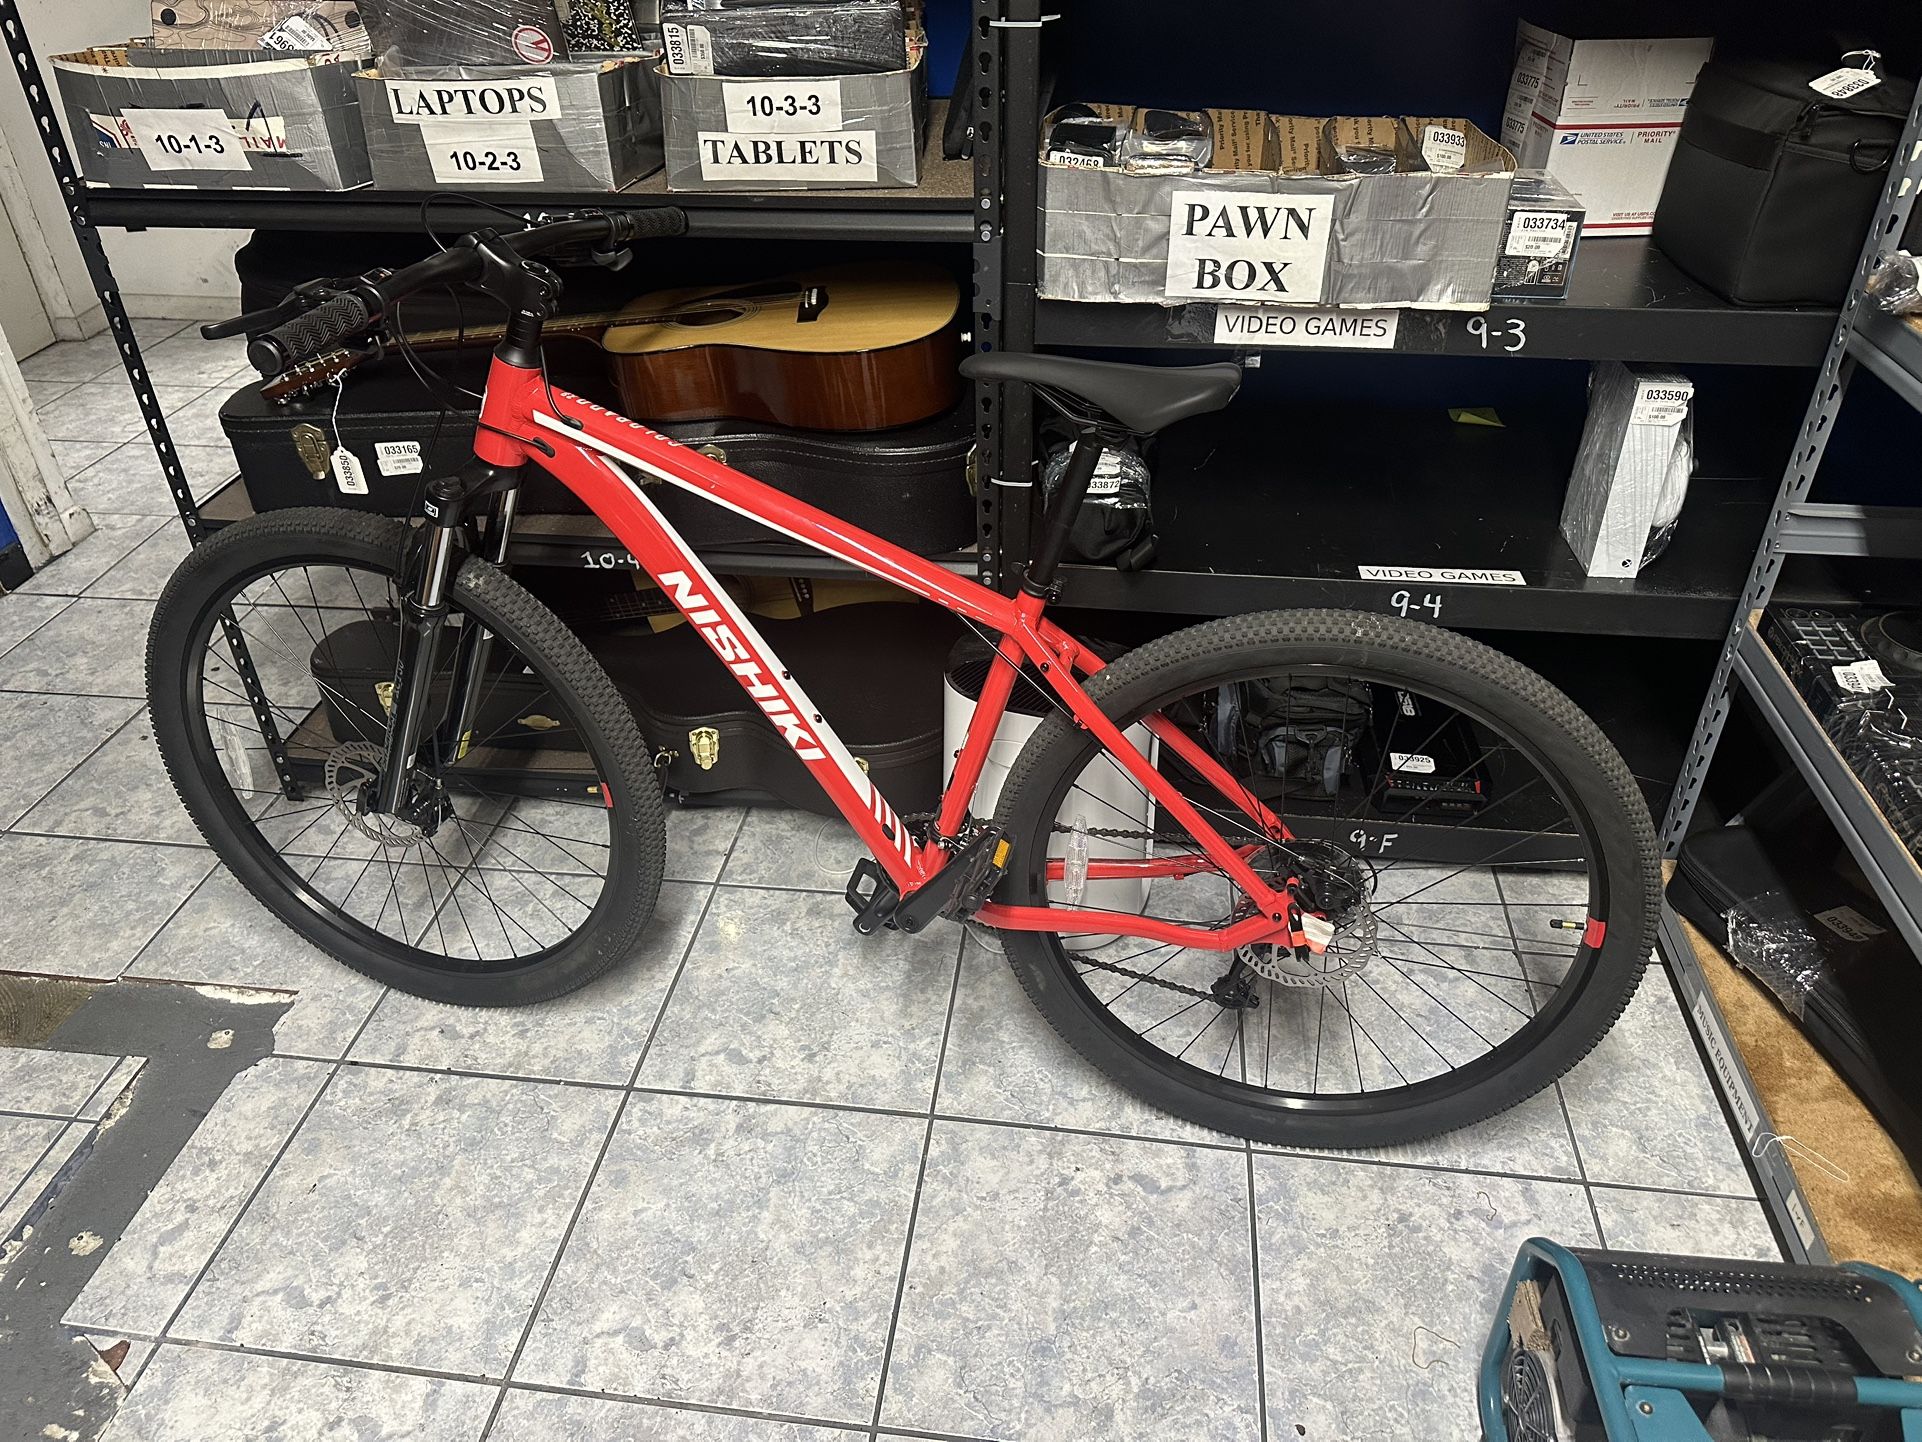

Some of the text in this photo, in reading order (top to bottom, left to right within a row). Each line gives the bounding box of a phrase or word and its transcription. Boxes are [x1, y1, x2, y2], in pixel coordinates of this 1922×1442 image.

[668, 27, 685, 65] 033815
[1516, 72, 1540, 89] 033775
[390, 86, 547, 116] LAPTOPS
[746, 94, 821, 117] 10-3-3
[1505, 116, 1526, 134] 033775
[155, 134, 225, 154] 10-1-3
[1433, 131, 1465, 148] 033933
[450, 151, 521, 171] 10-2-3
[703, 139, 863, 165] TABLETS
[1181, 203, 1317, 241] PAWN
[1523, 217, 1566, 230] 033734
[1192, 258, 1293, 293] BOX
[1224, 314, 1388, 337] VIDEO GAMES
[1466, 315, 1527, 352] 9-3
[1646, 389, 1689, 401] 033590
[384, 444, 419, 455] 033165
[340, 455, 356, 487] 033850
[1088, 480, 1120, 490] 33872
[1366, 568, 1516, 583] VIDEO GAMES
[1390, 590, 1443, 619] 9-4
[656, 570, 827, 761] NISHIKI
[1695, 1004, 1754, 1134] MUSIC EQUIPMENT
